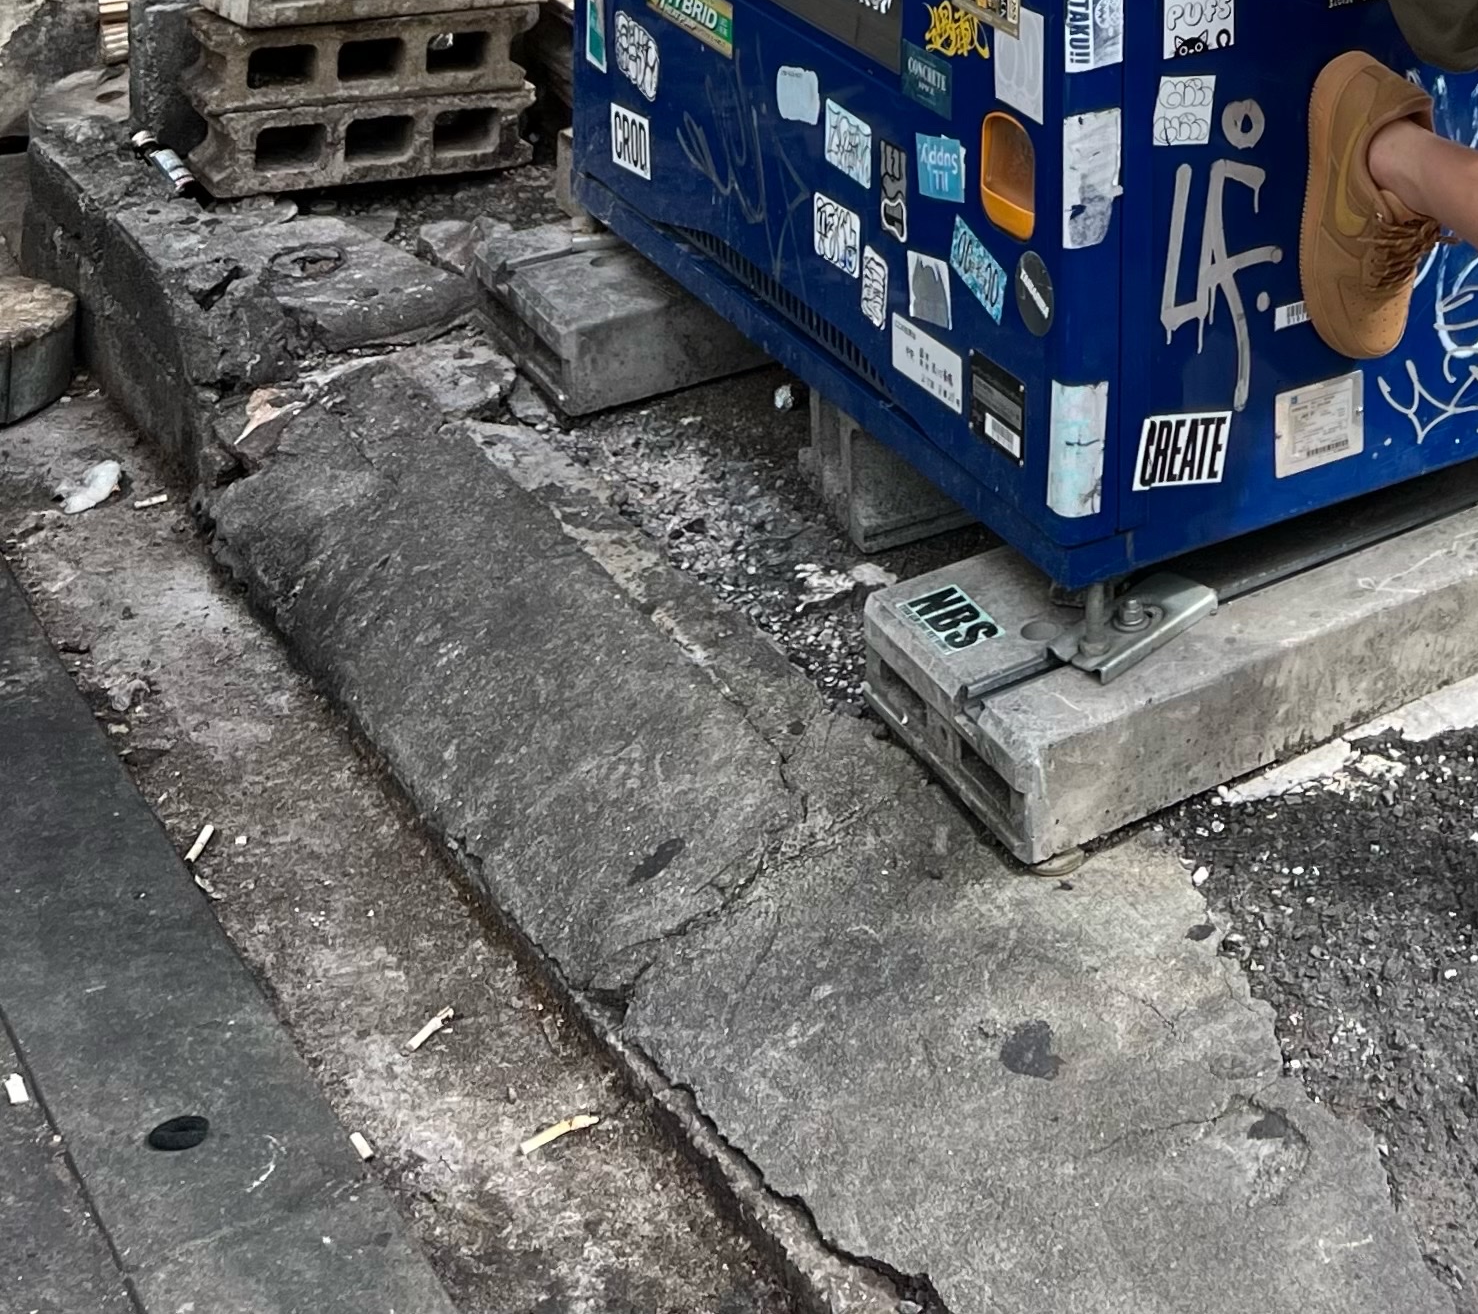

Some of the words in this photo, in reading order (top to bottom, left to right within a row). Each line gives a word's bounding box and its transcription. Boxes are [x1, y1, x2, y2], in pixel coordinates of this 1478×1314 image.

[907, 56, 947, 92] CONCRETE
[1140, 417, 1225, 489] CREATE
[907, 586, 999, 649] NBS
